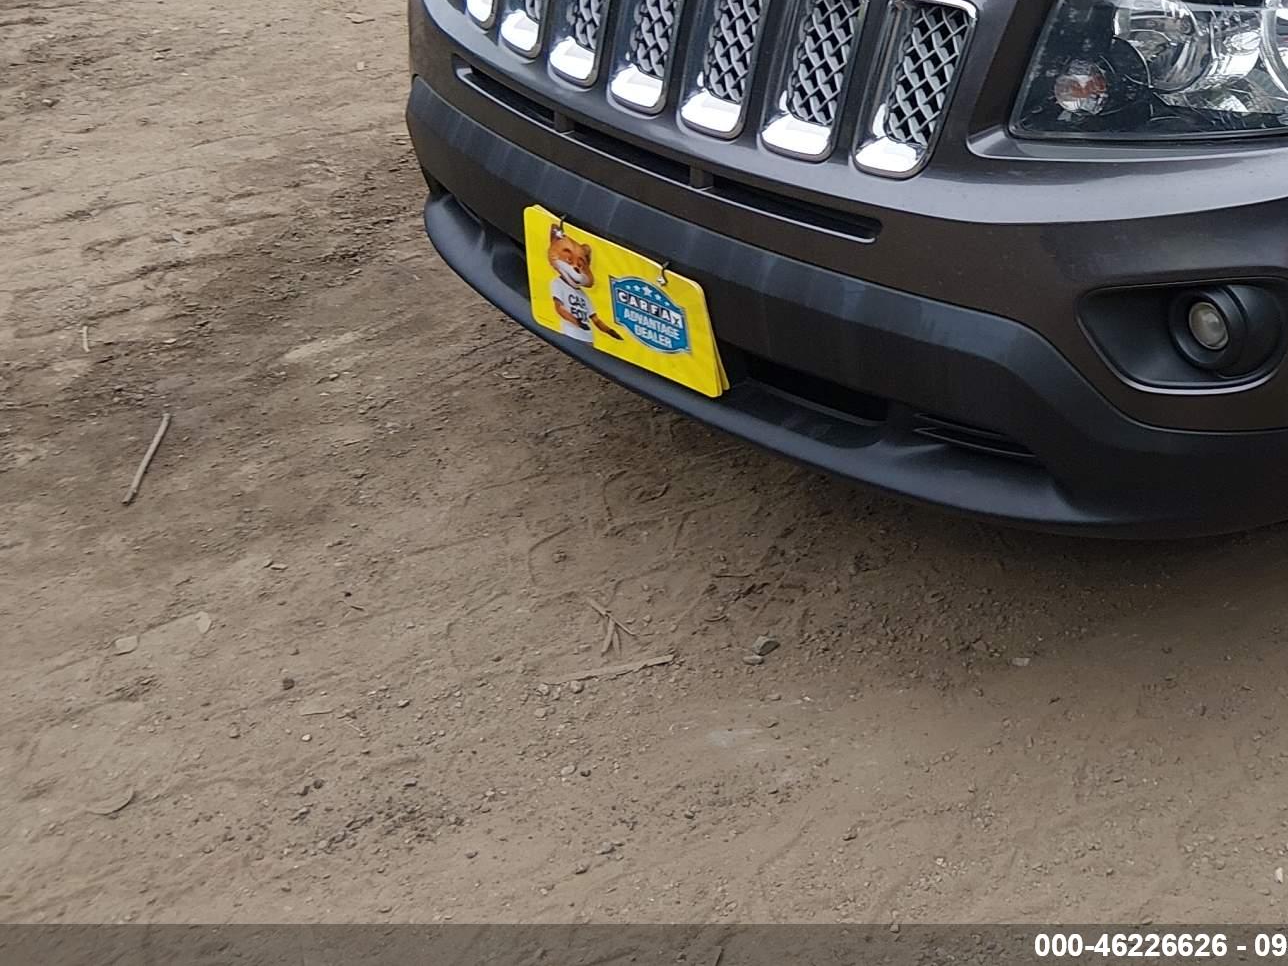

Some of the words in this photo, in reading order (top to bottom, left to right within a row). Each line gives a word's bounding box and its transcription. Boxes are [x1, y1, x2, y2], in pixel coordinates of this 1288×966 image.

[617, 291, 683, 328] CARFAX
[623, 307, 681, 340] ADVANTAGE
[634, 323, 673, 349] DEALER
